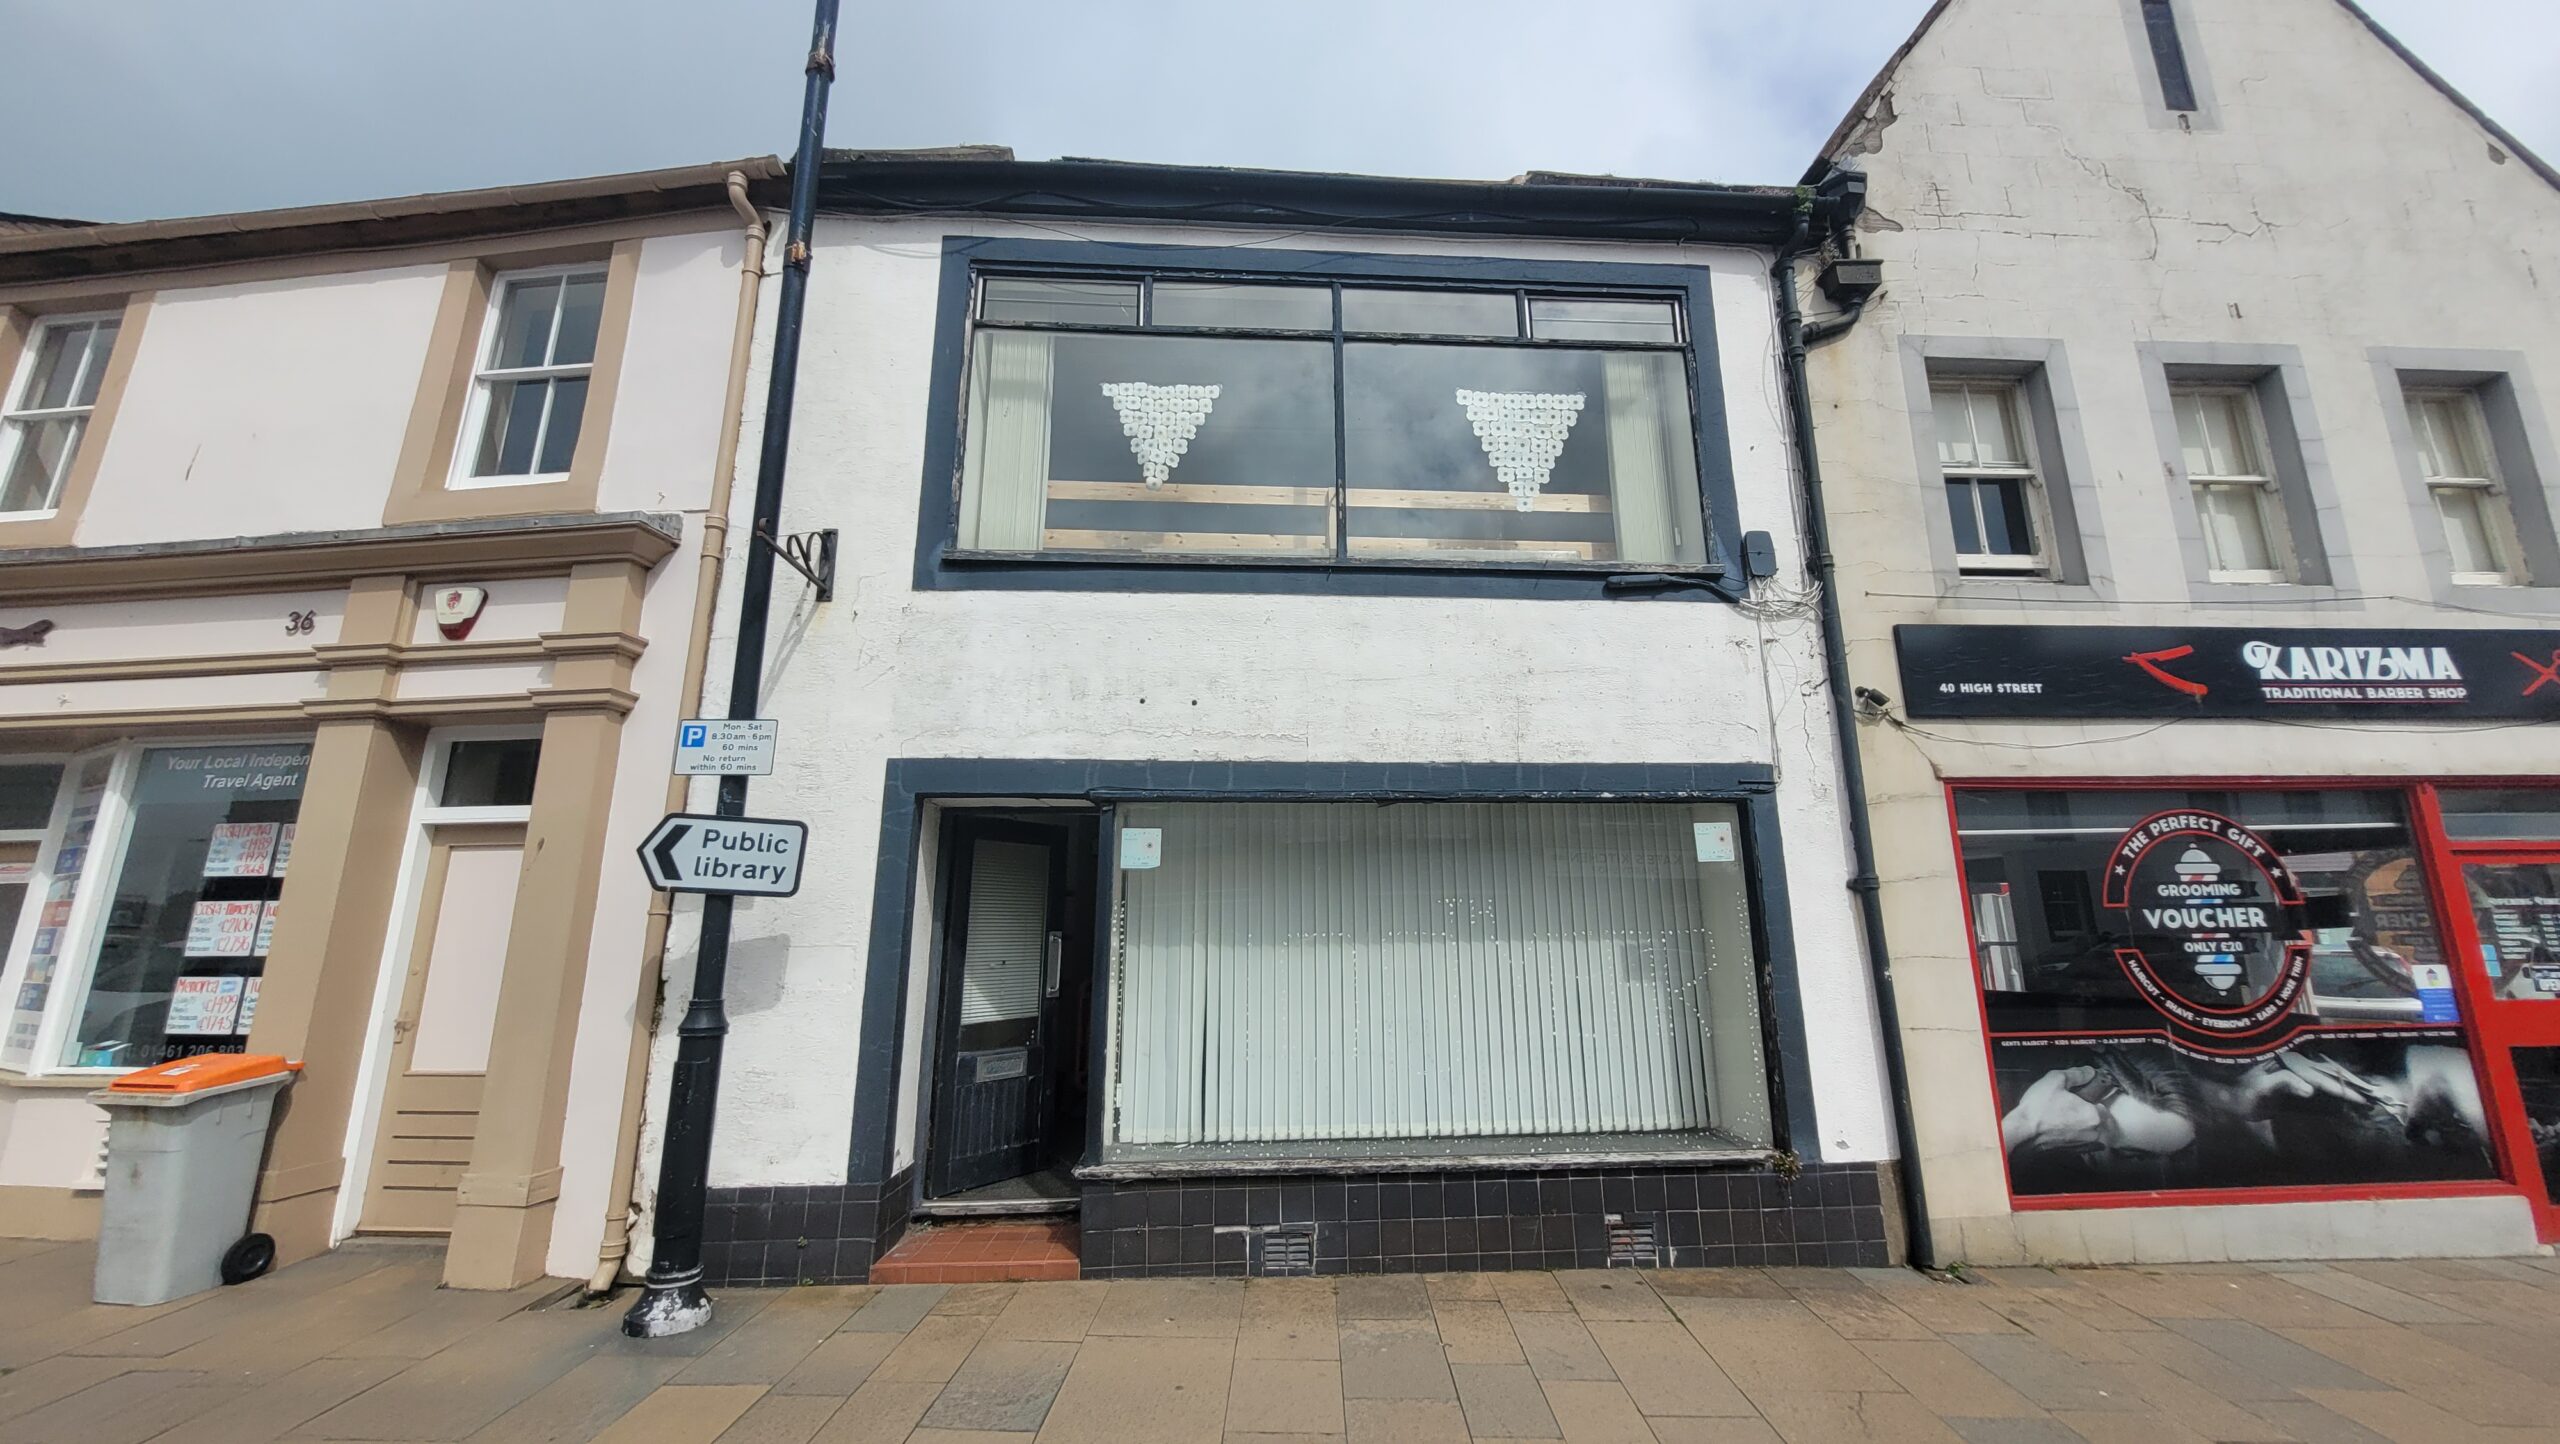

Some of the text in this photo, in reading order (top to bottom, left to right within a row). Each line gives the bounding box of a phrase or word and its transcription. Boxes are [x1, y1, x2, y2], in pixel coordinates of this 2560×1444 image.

[285, 610, 315, 634] 36
[2243, 641, 2463, 680] KARIZMA
[1939, 683, 2042, 693] 40 HIGH STREET
[2262, 687, 2467, 699] TRADITIONAL BARBER SHOP
[749, 723, 763, 731] Sat
[687, 728, 703, 746] P
[752, 733, 772, 742] 6pm
[167, 756, 201, 770] Your
[204, 754, 247, 769] Local
[720, 763, 733, 771] 60
[203, 772, 299, 790] Travel Agent
[702, 829, 789, 854] Public
[2122, 815, 2266, 859] THE PERFECT GIFT
[694, 856, 787, 885] library
[2157, 884, 2241, 897] GROOMING
[2142, 907, 2268, 929] VOUCHER
[2184, 942, 2243, 952] ONLY £20
[2128, 959, 2161, 996] HAIRCUT
[2164, 1000, 2195, 1021] SHAVE
[2202, 1018, 2251, 1028] EYEBROWS
[2256, 1004, 2277, 1021] EARS
[2291, 956, 2304, 977] TRIM
